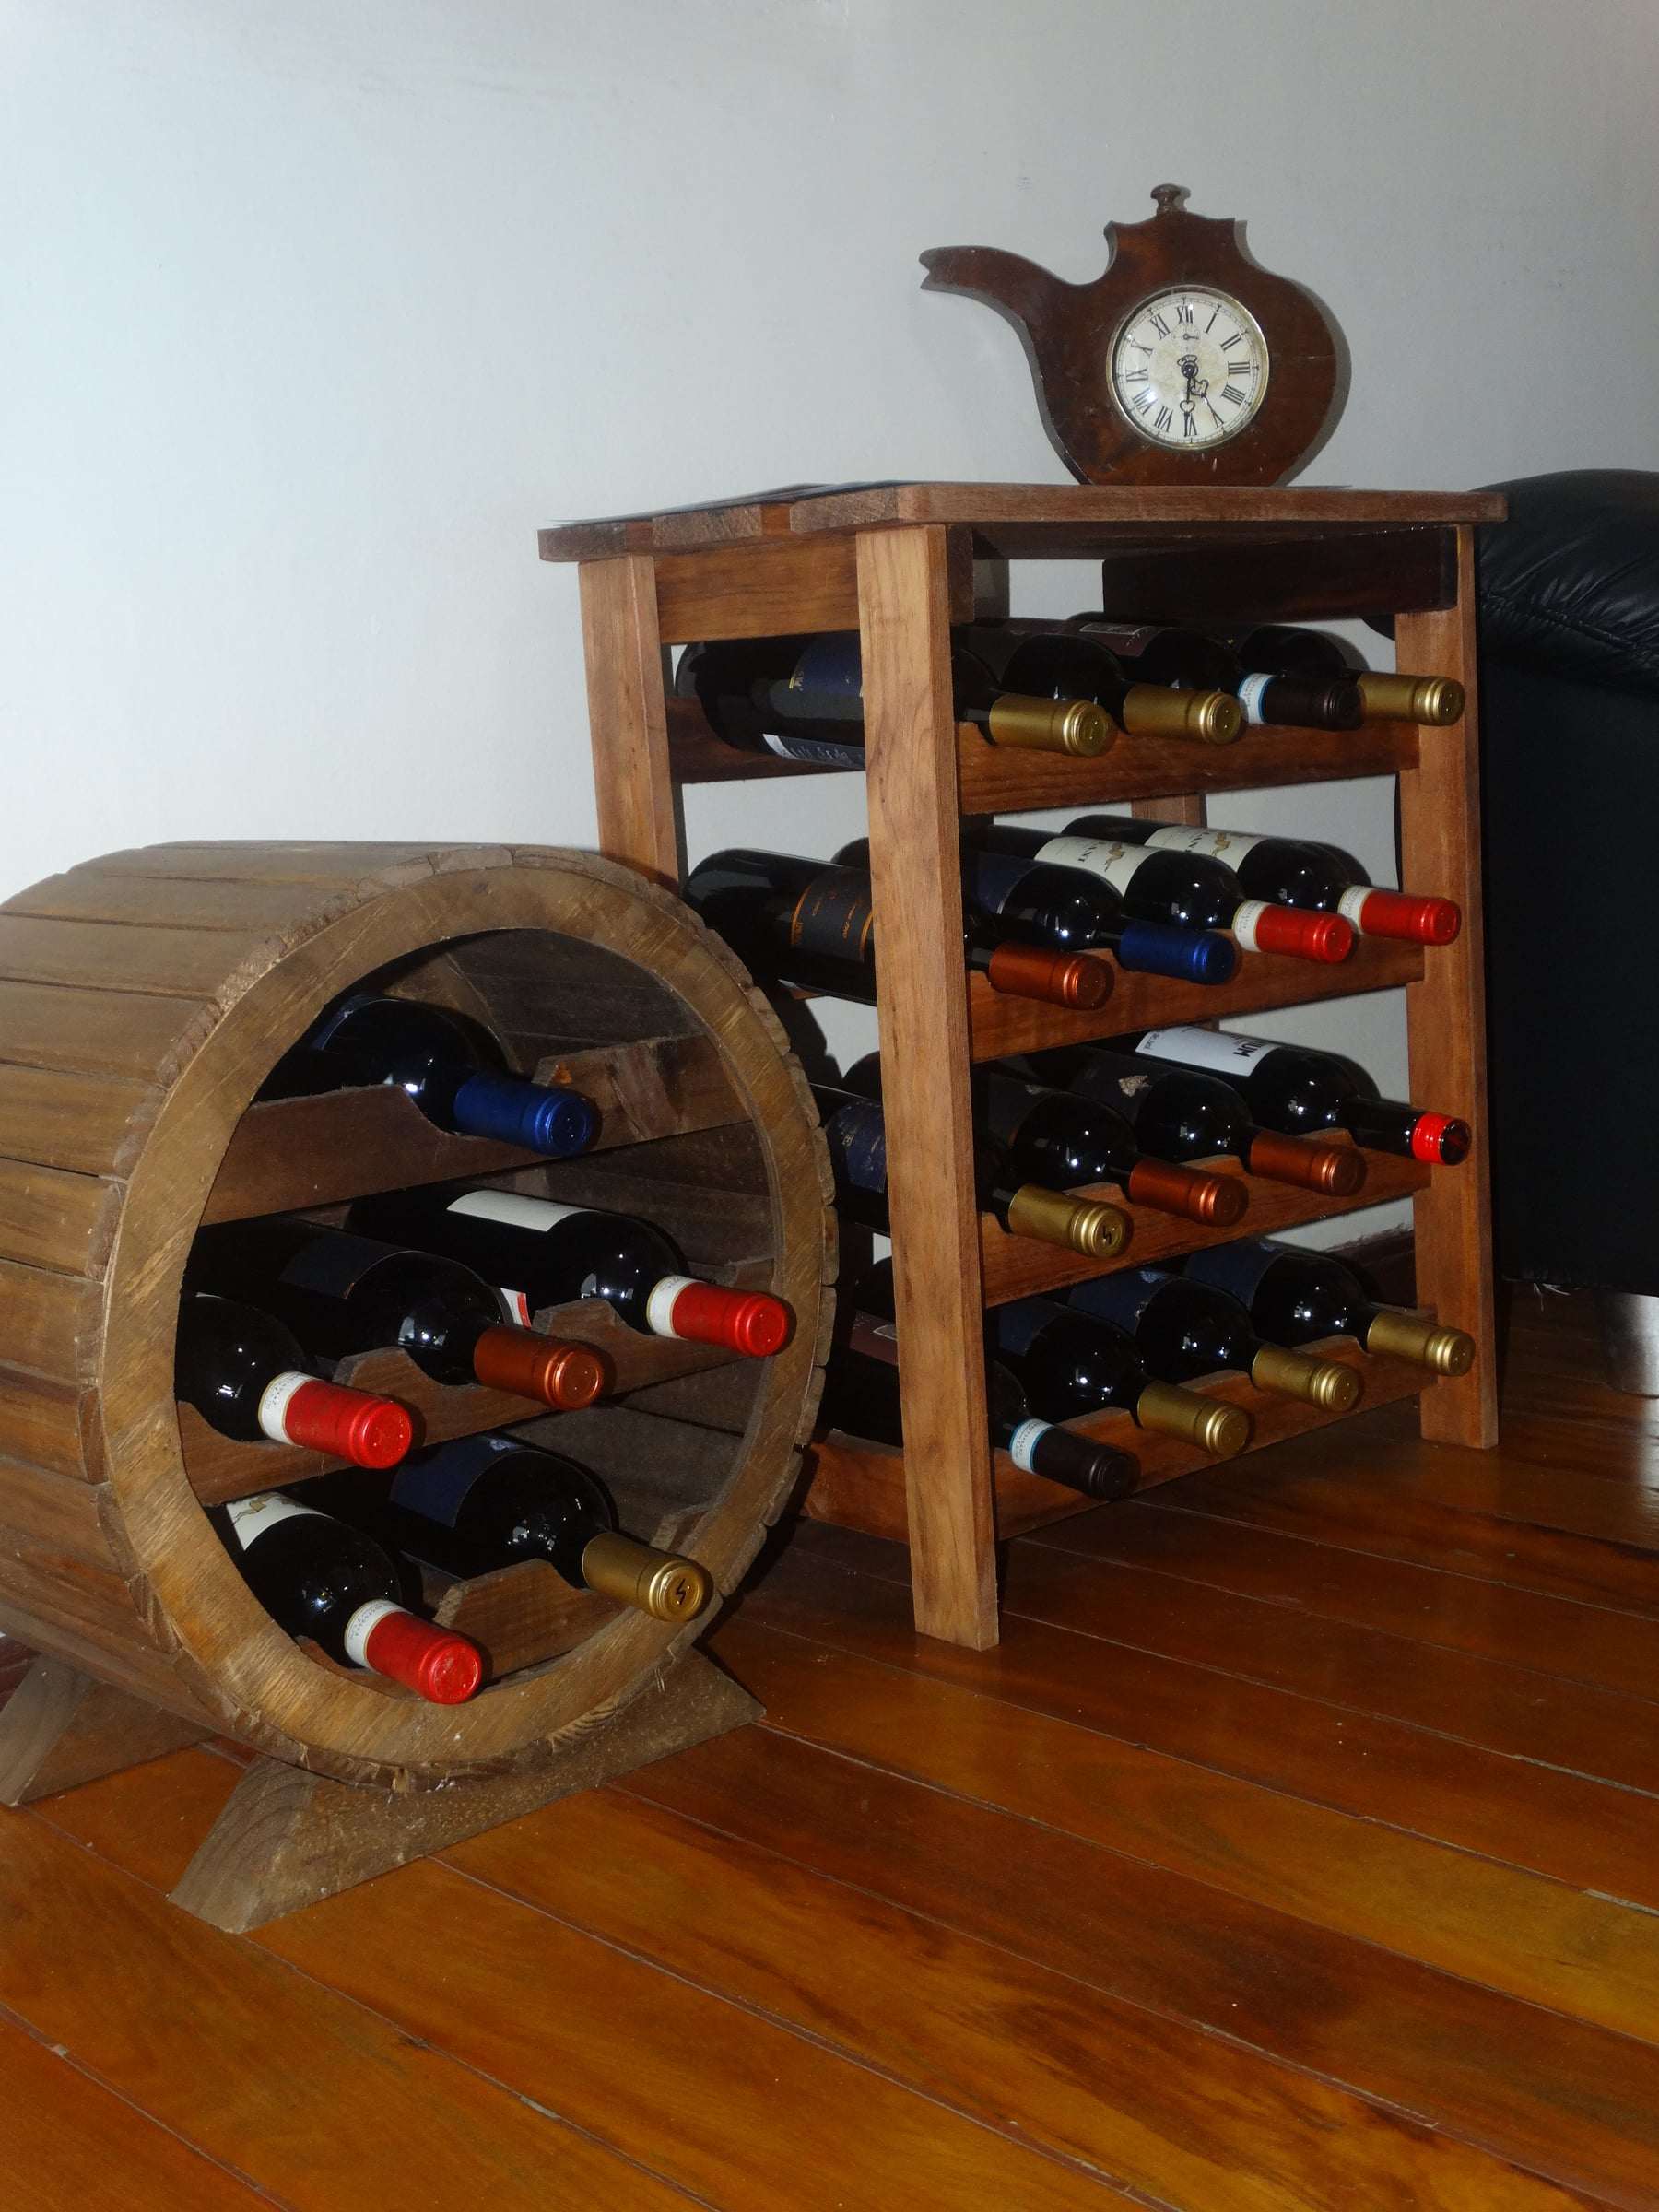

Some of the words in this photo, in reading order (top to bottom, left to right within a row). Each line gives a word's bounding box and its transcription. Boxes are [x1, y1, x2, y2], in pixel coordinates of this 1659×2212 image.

[1175, 305, 1194, 324] XII
[1149, 313, 1171, 340] XI
[1130, 339, 1153, 358] X
[1220, 333, 1241, 351] II
[1125, 368, 1148, 382] IX
[1228, 361, 1250, 376] III
[1154, 406, 1173, 432] VII
